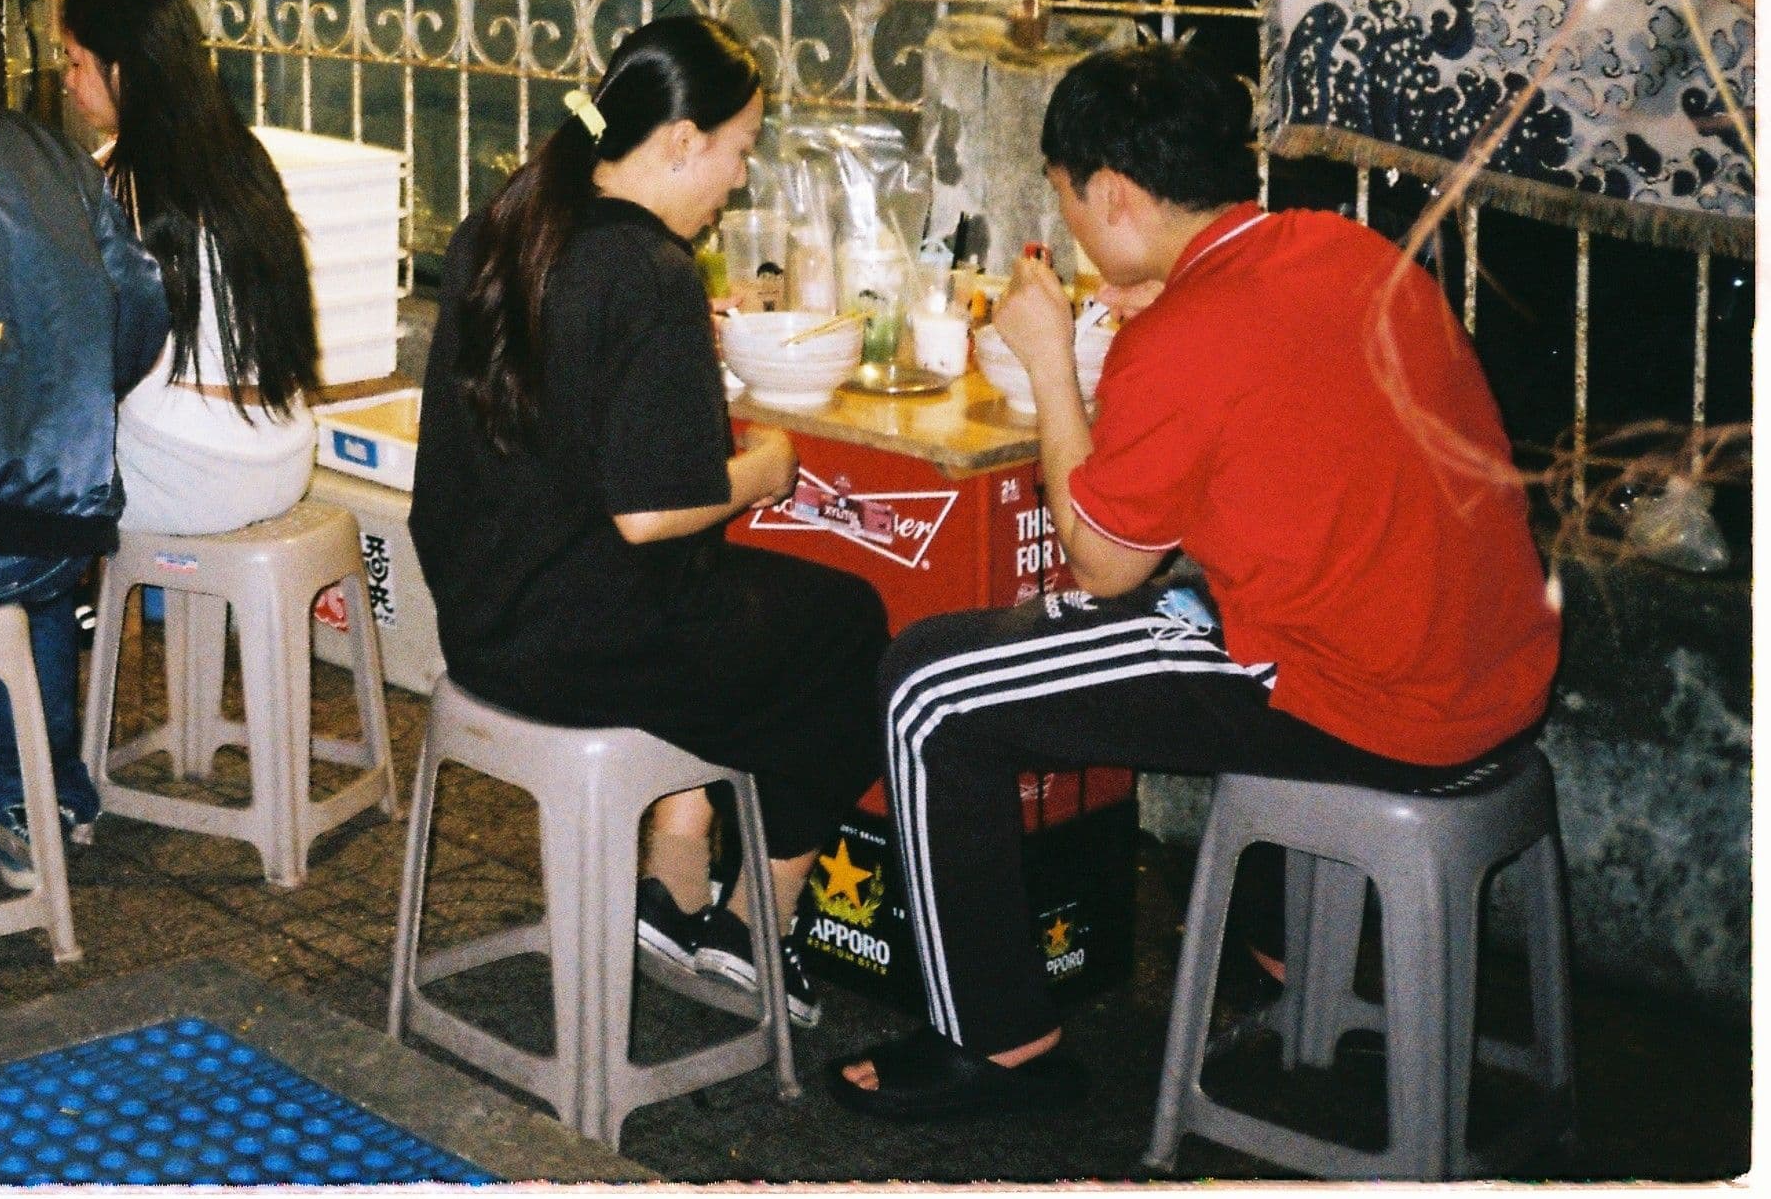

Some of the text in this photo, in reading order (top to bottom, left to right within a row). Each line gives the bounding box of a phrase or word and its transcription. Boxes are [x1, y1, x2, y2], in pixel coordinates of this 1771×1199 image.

[1015, 540, 1053, 577] FOR
[809, 917, 891, 966] APPORO
[1045, 947, 1085, 976] PPORO
